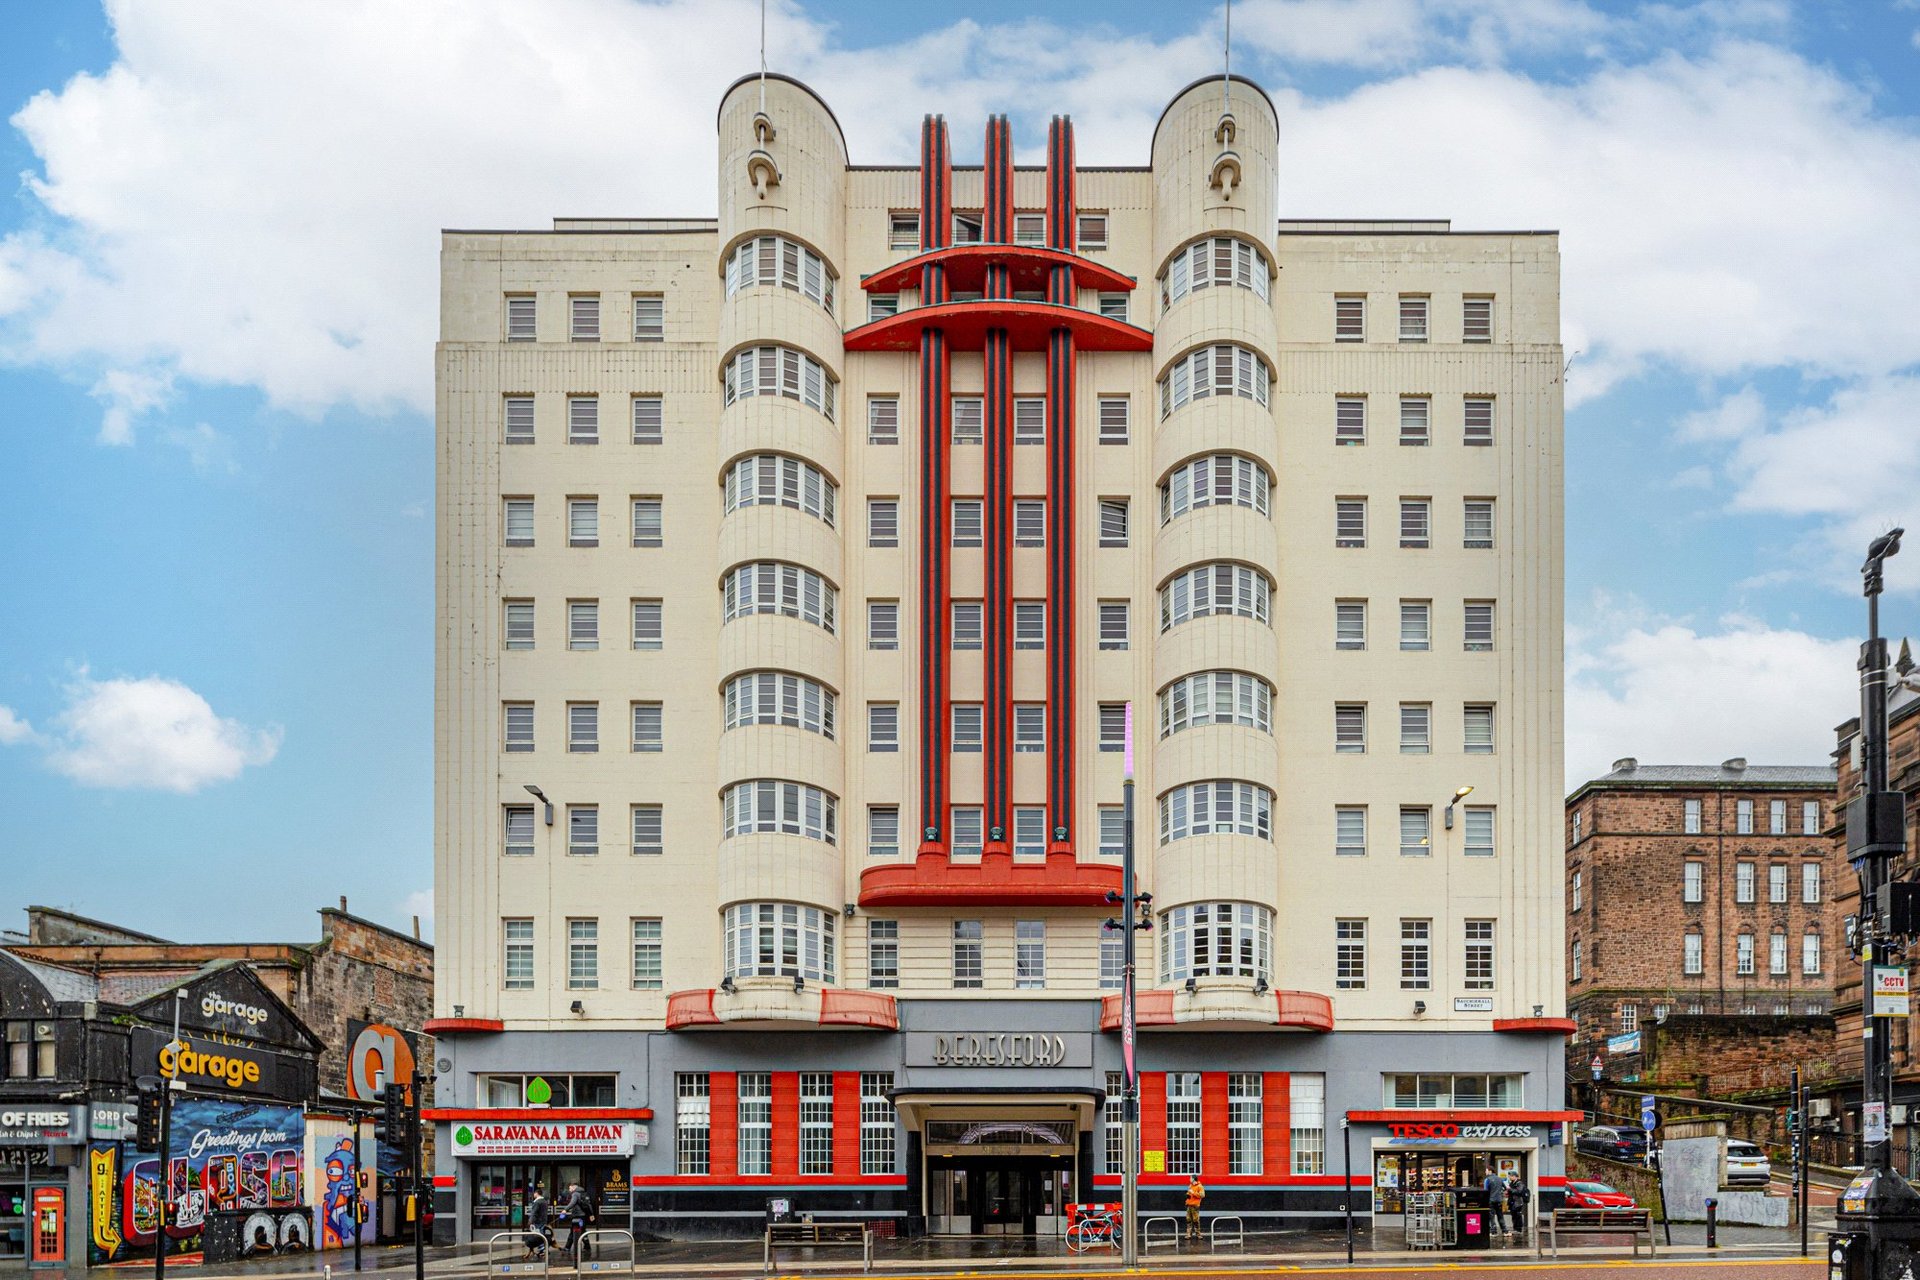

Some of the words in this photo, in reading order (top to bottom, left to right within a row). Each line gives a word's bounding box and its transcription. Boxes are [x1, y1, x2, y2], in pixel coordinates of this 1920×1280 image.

[1885, 977, 1904, 986] CCTV
[209, 991, 221, 1000] the
[202, 997, 268, 1025] garage
[933, 1034, 1065, 1066] BERESFORD
[159, 1047, 260, 1087] garage
[2, 1111, 26, 1126] OF
[27, 1111, 69, 1127] FRIES
[93, 1109, 120, 1120] LORD
[474, 1125, 561, 1140] SARAVANAA
[565, 1125, 622, 1140] BHAVAN
[1388, 1123, 1459, 1138] TESCO
[1462, 1123, 1531, 1140] express
[189, 1128, 256, 1158] Greetings
[256, 1129, 286, 1149] from
[226, 1161, 237, 1194] BOX
